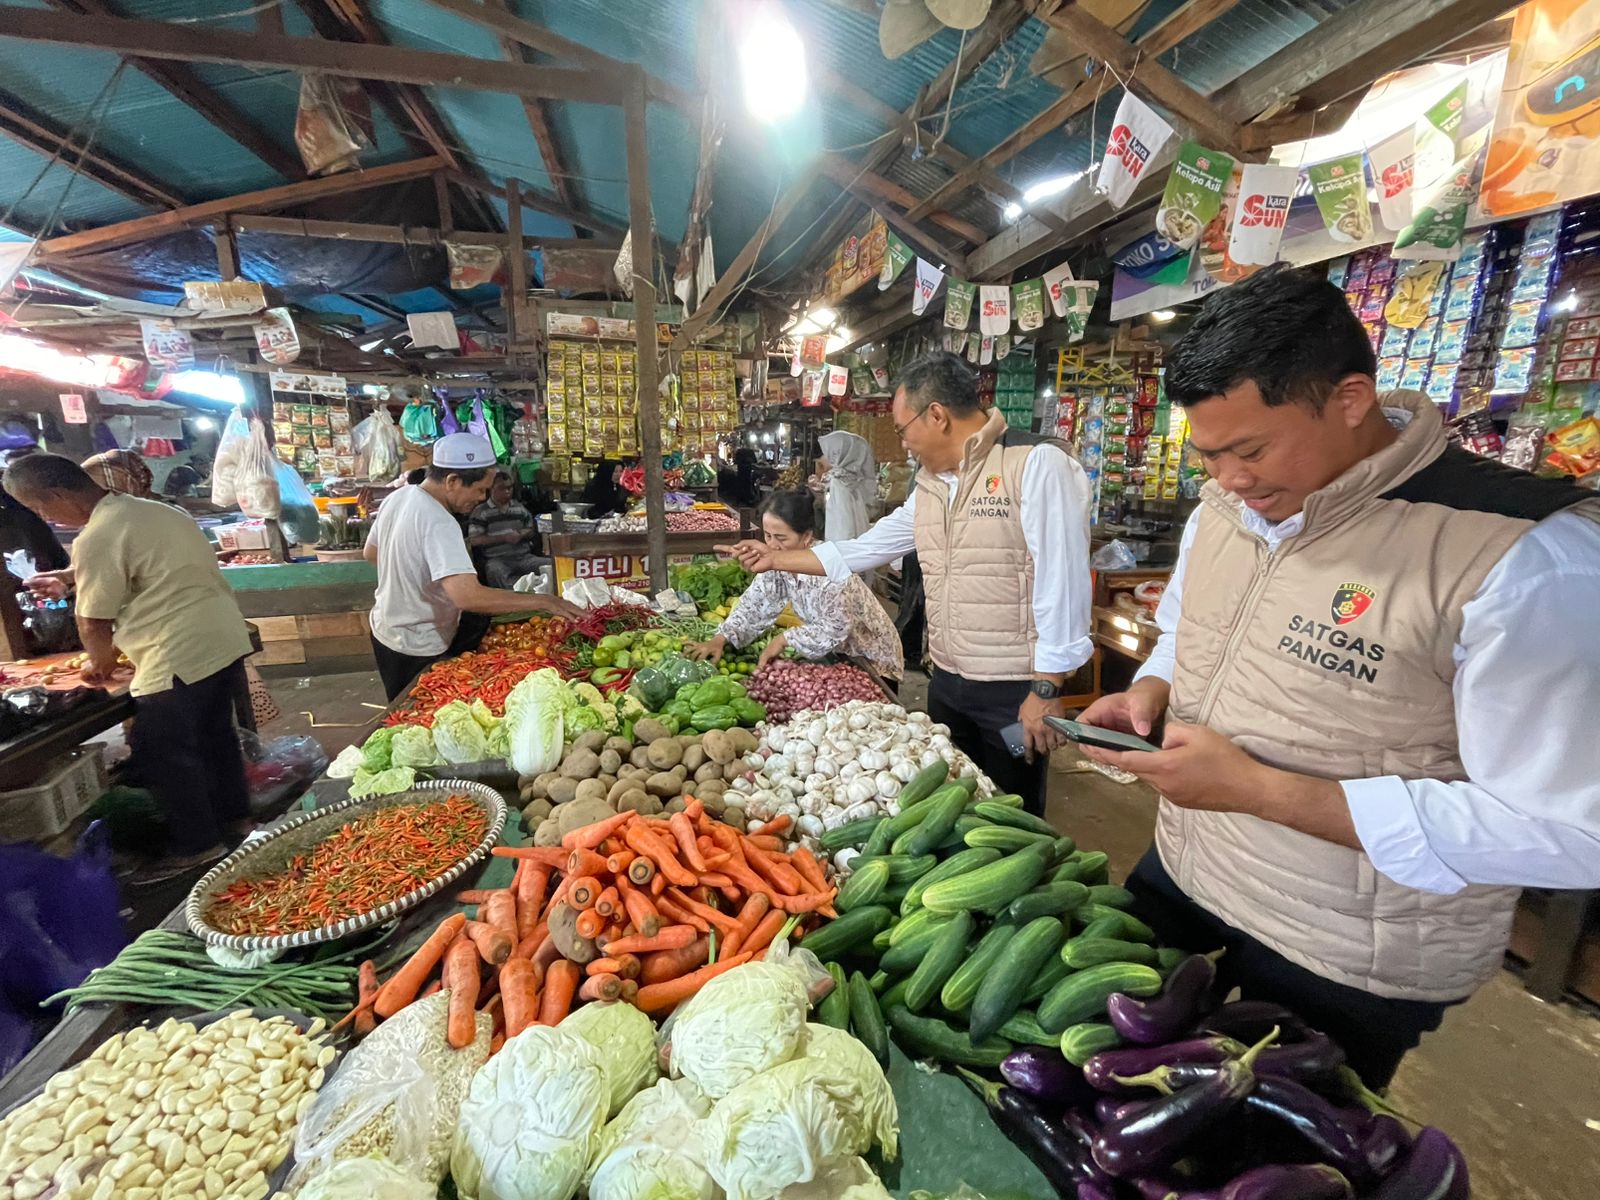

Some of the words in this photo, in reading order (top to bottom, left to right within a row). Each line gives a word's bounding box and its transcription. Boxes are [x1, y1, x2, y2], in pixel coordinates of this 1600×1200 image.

[1105, 124, 1143, 178] SUN
[1131, 137, 1149, 159] kara
[1176, 165, 1204, 185] Kelapa
[1204, 180, 1222, 193] Asli
[1318, 178, 1352, 194] Kelapa
[1240, 194, 1285, 228] SUN
[1268, 194, 1287, 207] kara
[983, 300, 1008, 317] SUN
[971, 496, 1010, 506] SATGAS
[970, 508, 1009, 518] PANGAN
[576, 555, 628, 578] BELI
[1288, 614, 1386, 662] SATGAS
[1278, 635, 1378, 684] PANGAN
